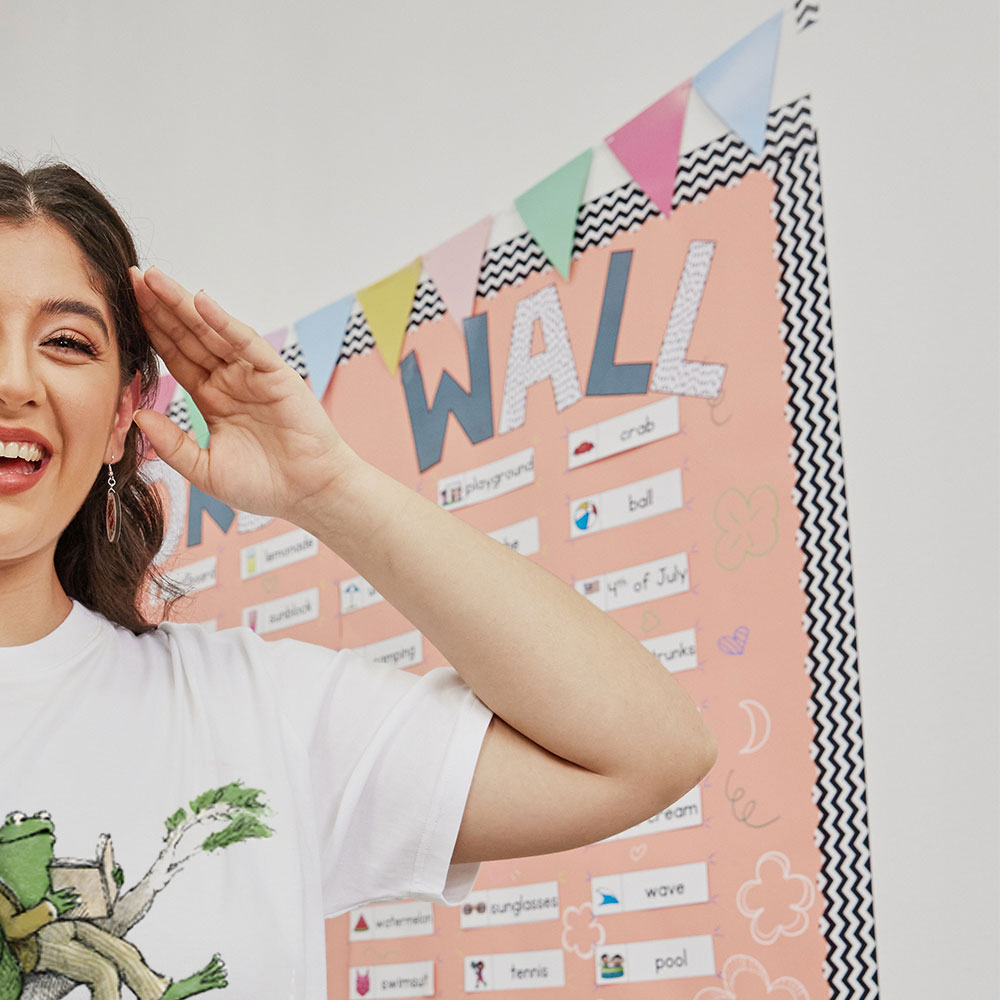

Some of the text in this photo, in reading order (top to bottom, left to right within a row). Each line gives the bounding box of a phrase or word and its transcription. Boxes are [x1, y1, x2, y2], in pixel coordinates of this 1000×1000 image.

[400, 240, 728, 473] WALL
[619, 416, 656, 442] crab
[465, 455, 535, 497] playground
[628, 488, 655, 512] ball
[634, 572, 651, 593] of
[656, 563, 688, 586] July
[644, 883, 685, 899] wave
[490, 894, 559, 917] sunglasses
[375, 913, 433, 930] watermelon
[511, 963, 550, 980] tennis
[655, 949, 689, 974] pool
